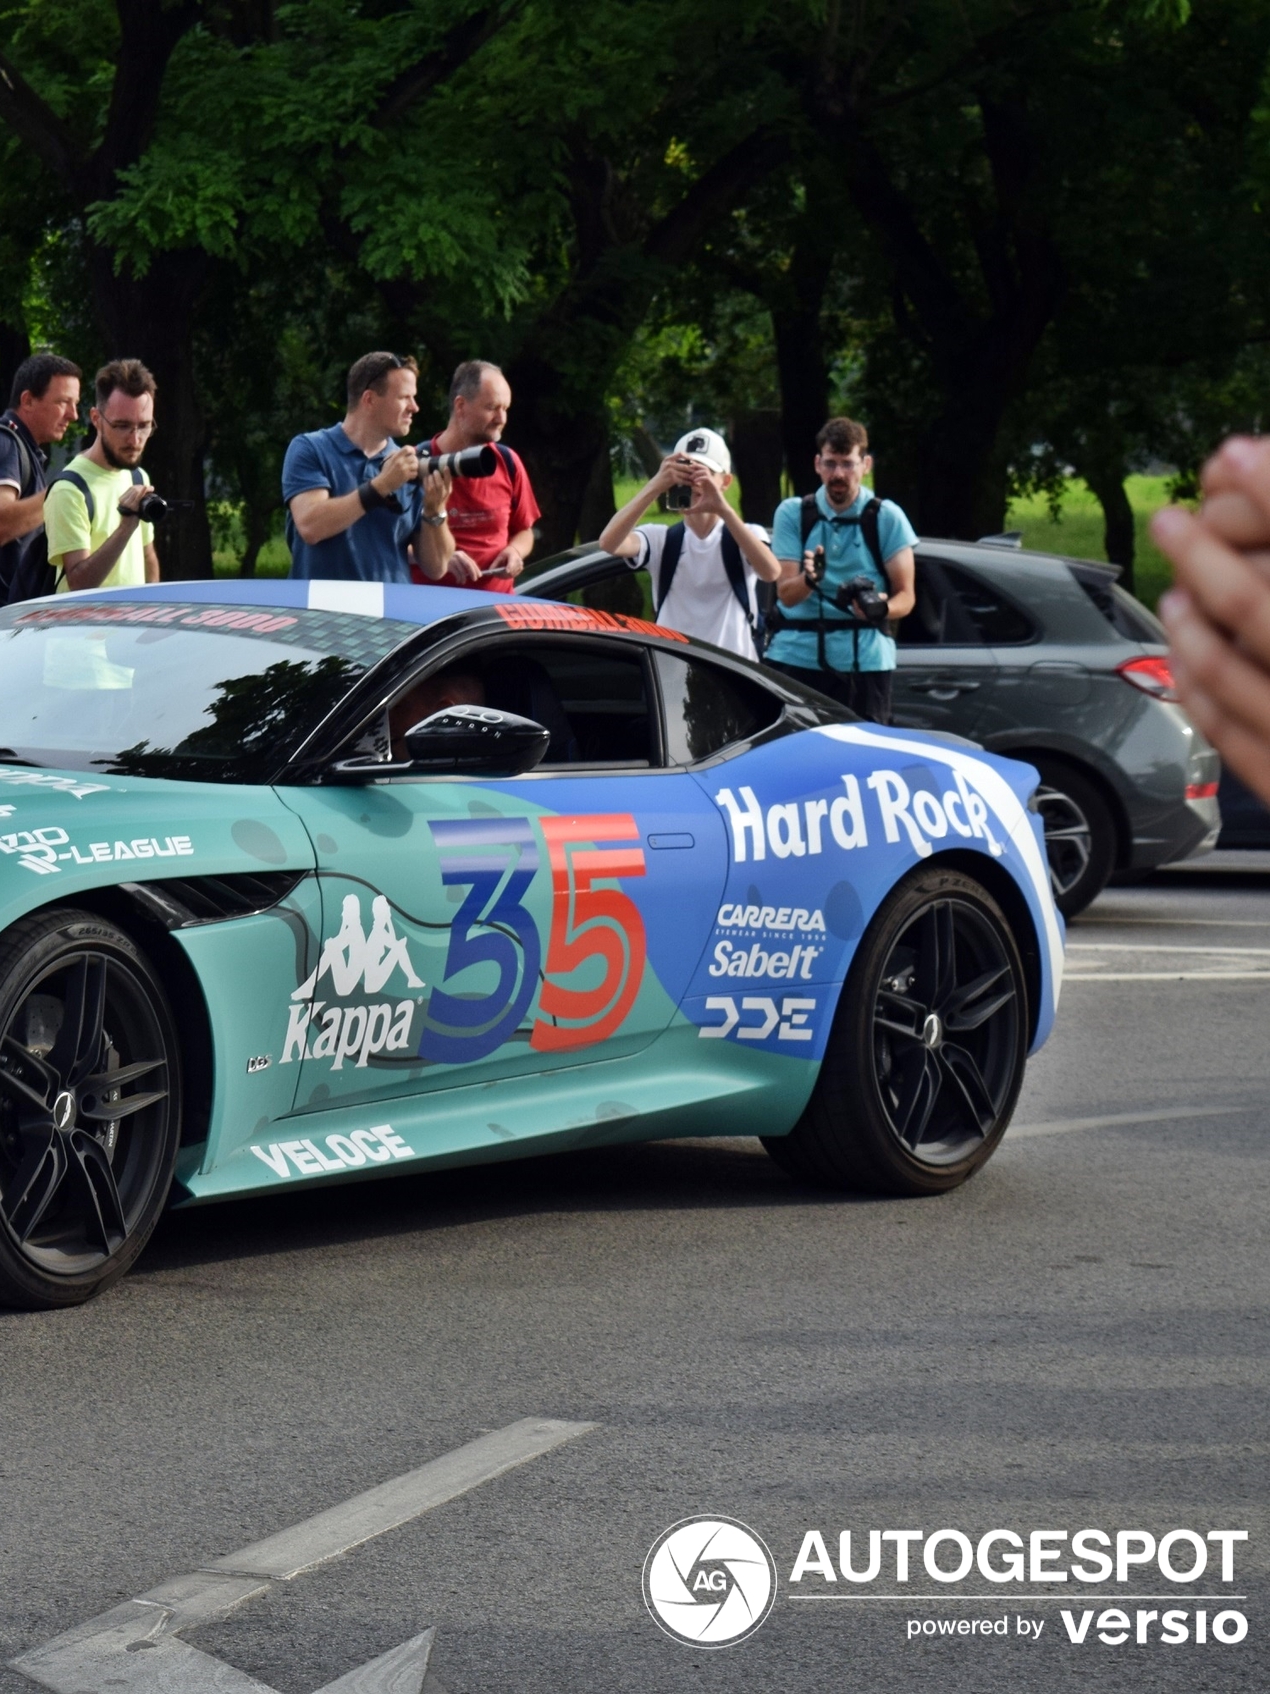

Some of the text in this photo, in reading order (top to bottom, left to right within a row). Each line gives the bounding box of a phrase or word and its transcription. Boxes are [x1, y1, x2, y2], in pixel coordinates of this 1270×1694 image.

[715, 769, 1003, 862] Hard Rock
[417, 813, 647, 1064] 35
[715, 928, 756, 938] EYEWEAR
[762, 931, 794, 940] SINCE
[717, 903, 826, 932] CARRERA
[709, 940, 819, 980] Sabelt
[279, 999, 415, 1071] Kappa
[698, 996, 817, 1041] DDE
[250, 1123, 416, 1178] VELOCE
